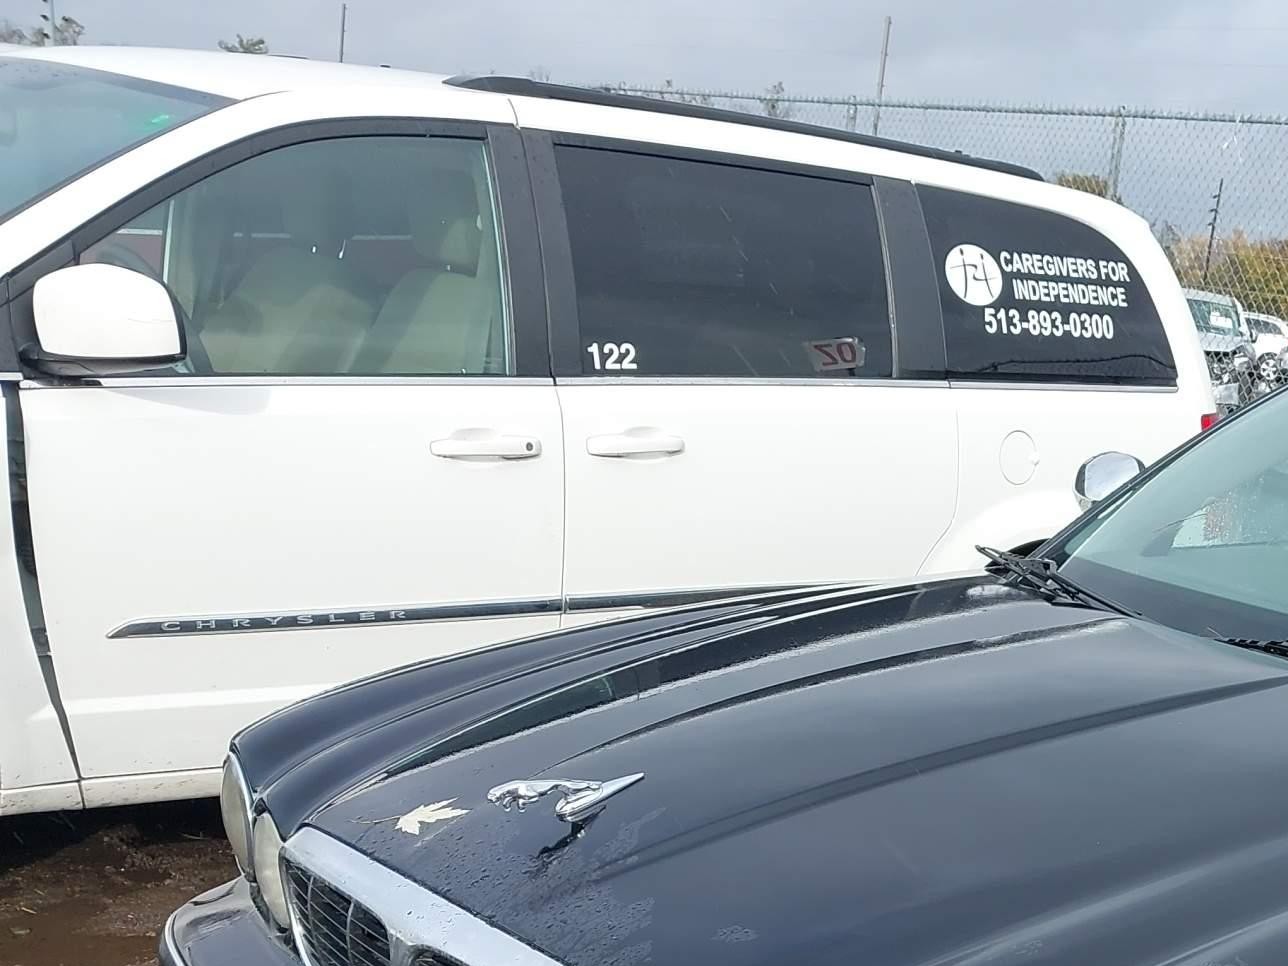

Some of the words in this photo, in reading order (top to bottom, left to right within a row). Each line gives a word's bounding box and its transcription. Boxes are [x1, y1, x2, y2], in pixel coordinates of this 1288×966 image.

[1000, 251, 1098, 279] CAREGIVERS
[1099, 260, 1130, 282] FOR
[1013, 278, 1128, 307] INDEPENDENCE
[984, 307, 1114, 340] 513-893-0300
[587, 342, 638, 370] 122
[160, 609, 407, 632] CHRYSLER
